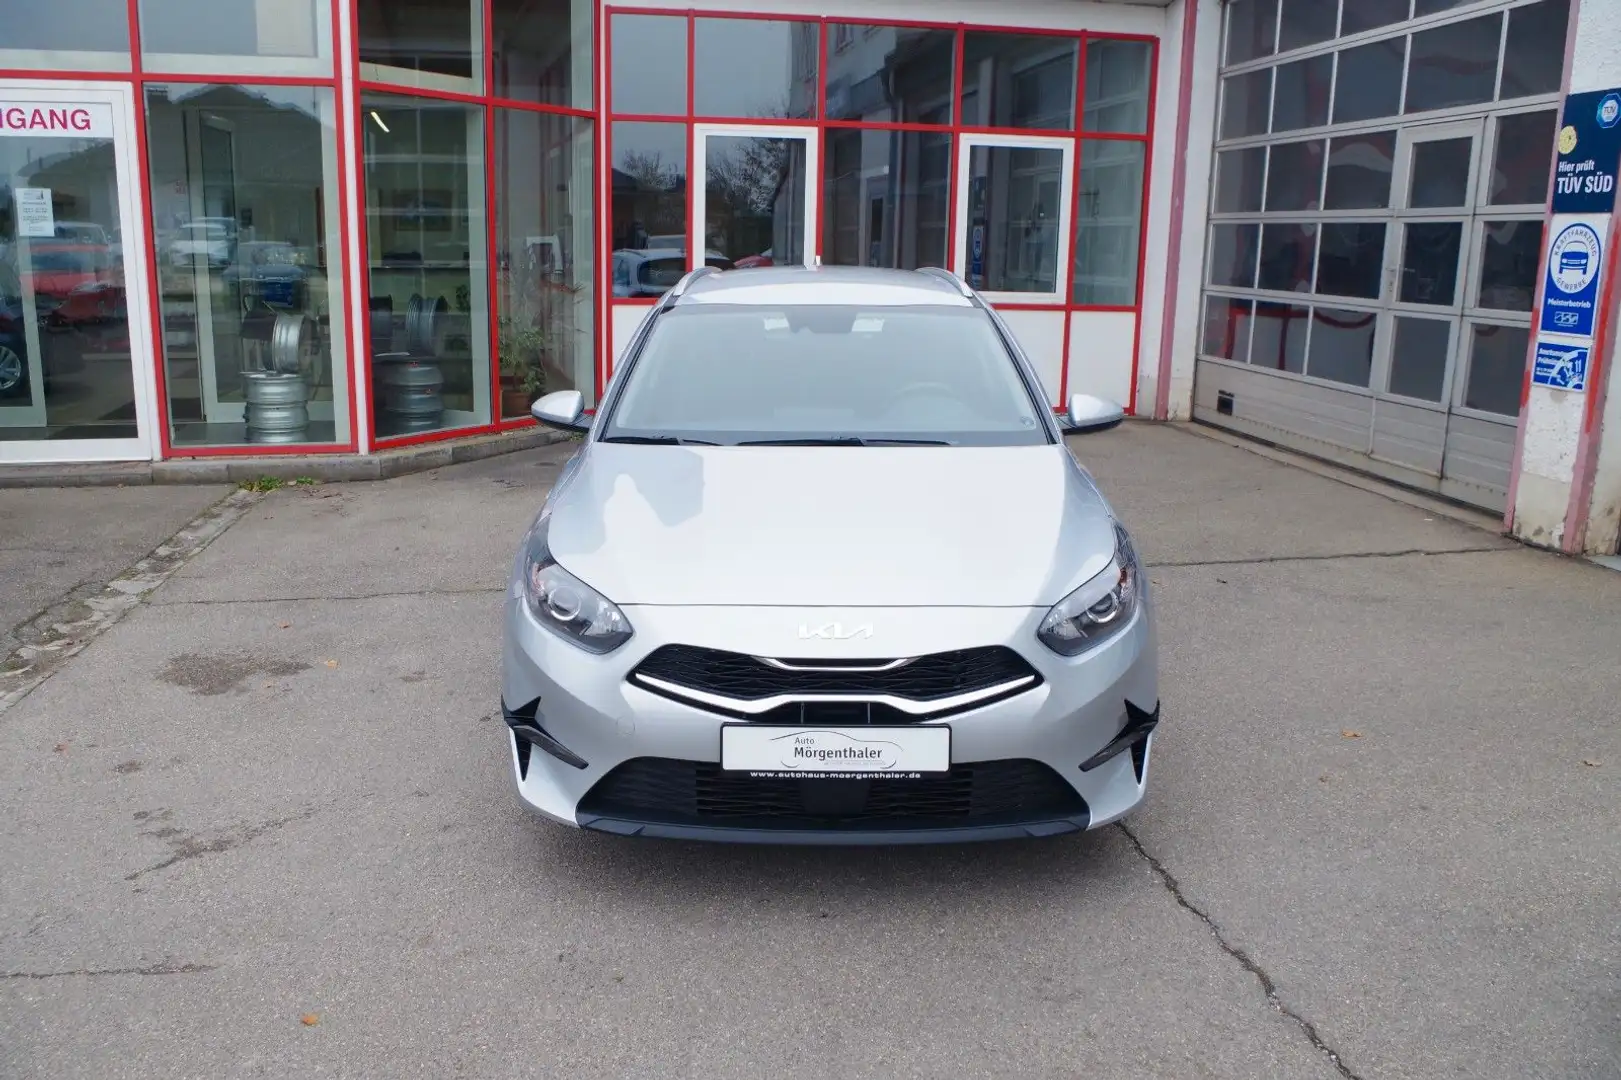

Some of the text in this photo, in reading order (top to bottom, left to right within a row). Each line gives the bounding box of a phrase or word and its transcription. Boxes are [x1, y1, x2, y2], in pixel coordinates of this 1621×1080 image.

[1558, 159, 1595, 174] Hier prüft
[1557, 171, 1613, 194] TÜV SÜD
[1554, 229, 1597, 257] KRAFTFAHRZEUG
[1556, 277, 1588, 291] GEWERBE
[1547, 298, 1591, 308] Meisterbetrieb
[798, 621, 874, 640] KIA
[794, 737, 815, 745] Auto
[794, 746, 883, 761] Mörgenthaler
[750, 771, 921, 780] www.autohaus-moergenthaler.de
